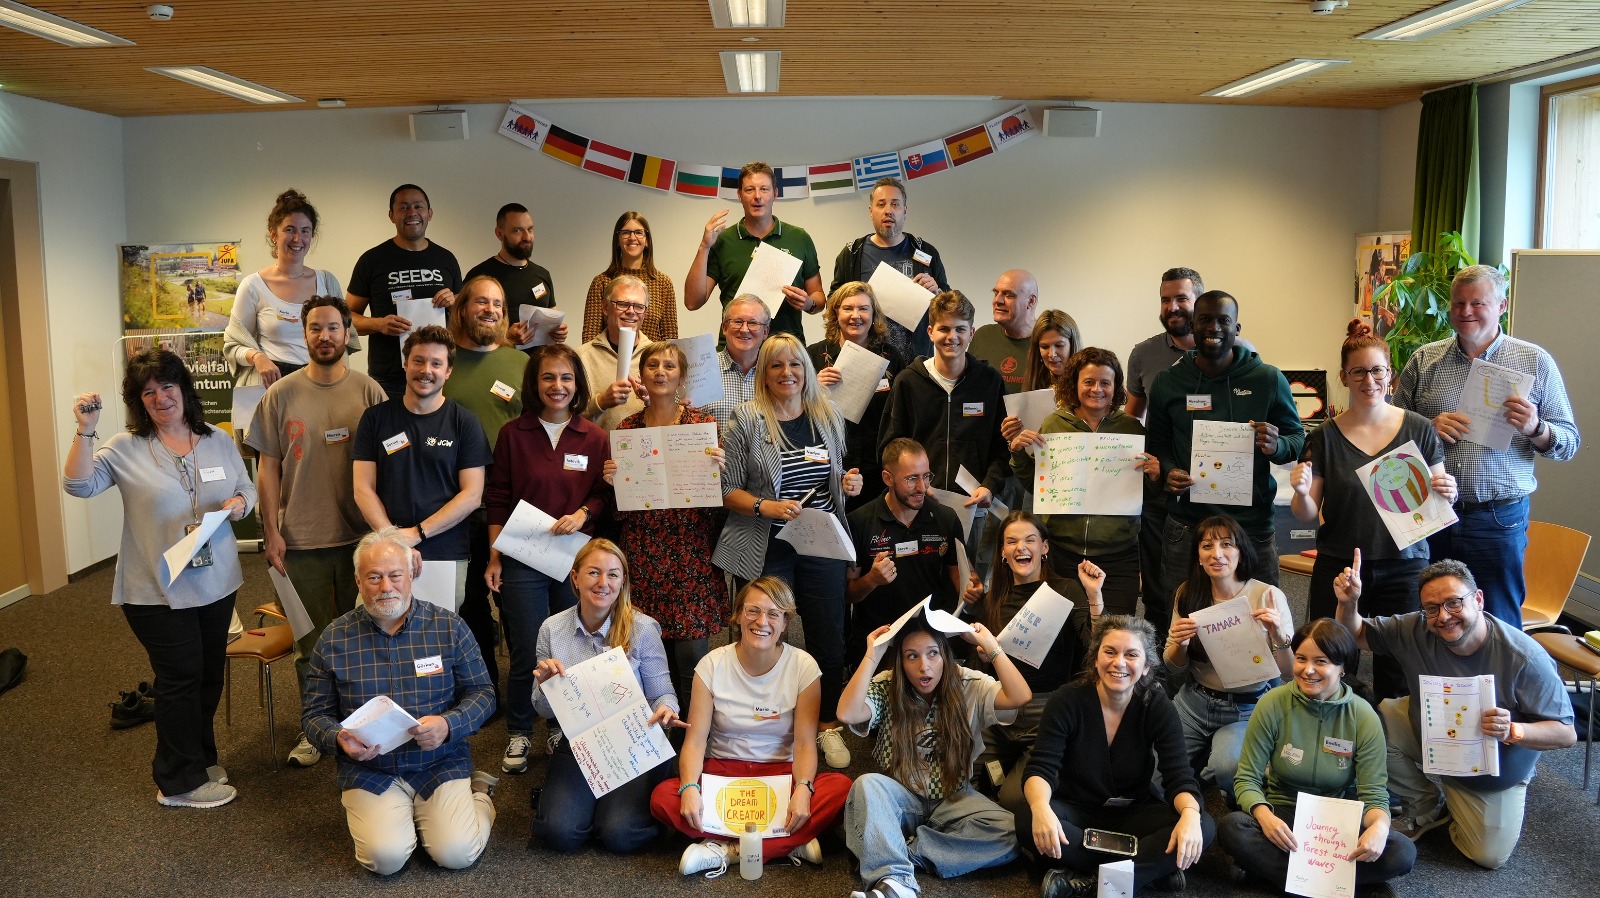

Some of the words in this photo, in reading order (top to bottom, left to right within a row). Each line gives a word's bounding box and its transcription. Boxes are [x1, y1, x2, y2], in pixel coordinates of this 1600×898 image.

[388, 269, 443, 284] SEEDS
[193, 379, 232, 390] ntum
[1202, 615, 1242, 635] TAMARA
[730, 798, 758, 807] DREAM
[726, 809, 765, 820] CREATOR
[1306, 816, 1340, 839] Journey
[1313, 834, 1347, 849] through
[1303, 841, 1328, 857] Forest
[1332, 851, 1351, 862] and
